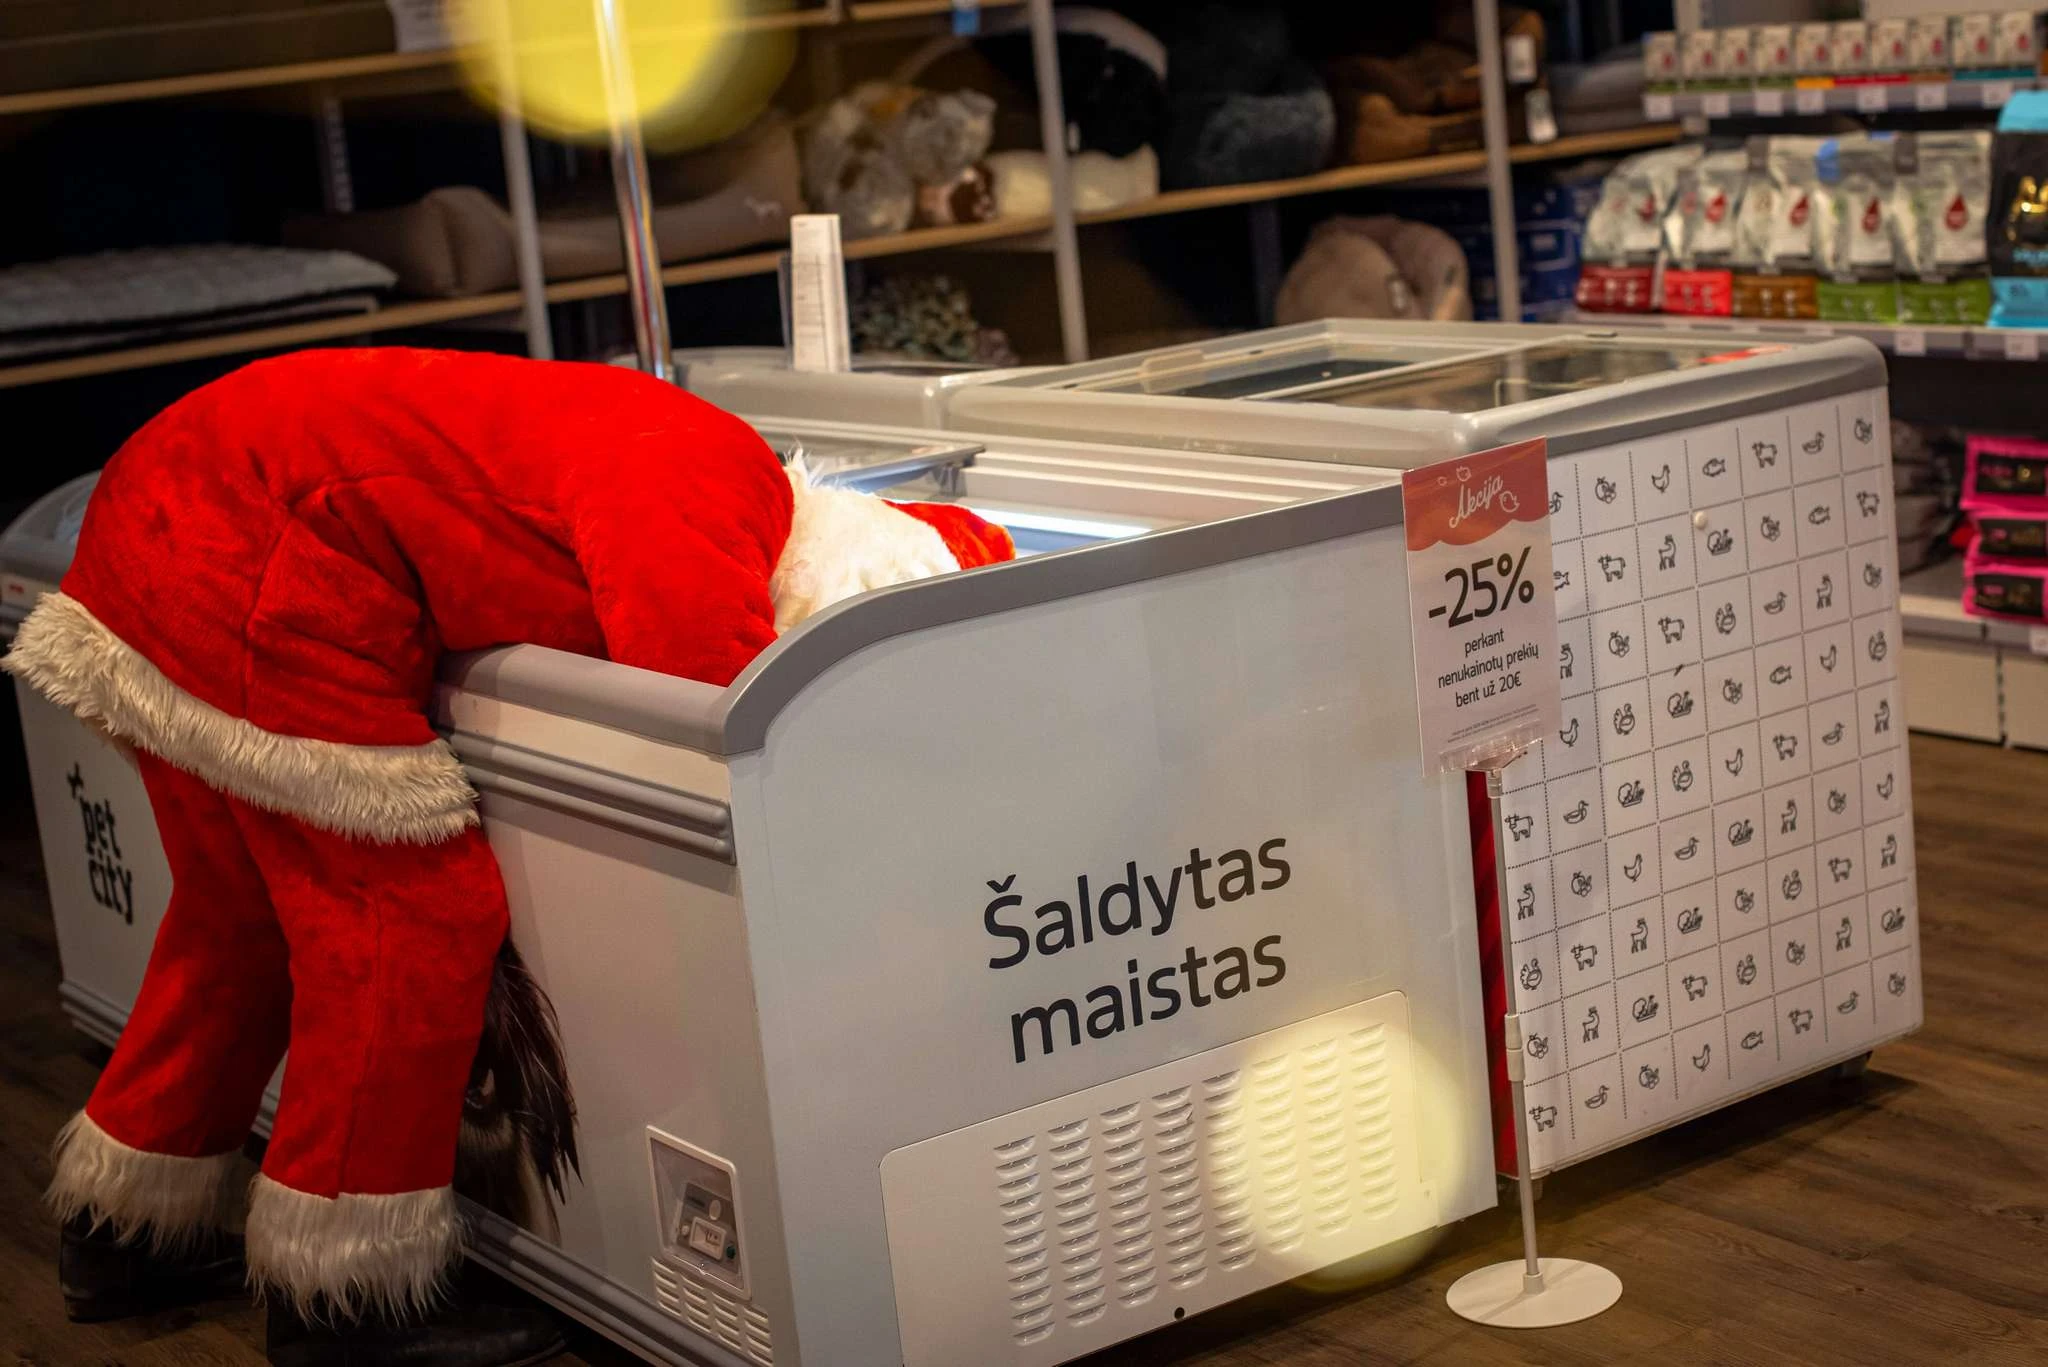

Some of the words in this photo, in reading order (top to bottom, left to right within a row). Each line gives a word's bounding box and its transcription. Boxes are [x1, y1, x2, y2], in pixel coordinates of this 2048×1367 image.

[1449, 475, 1503, 529] Akcija
[1428, 546, 1534, 628] -25%
[1438, 655, 1504, 688] nenukainotų
[1506, 643, 1539, 669] prekių
[1465, 628, 1504, 658] perkant
[1455, 687, 1480, 708] bent
[1482, 680, 1496, 699] už
[1498, 671, 1522, 693] 20€
[79, 797, 121, 859] pet
[88, 849, 133, 926] city
[983, 837, 1292, 970] Šaldytas
[1011, 934, 1287, 1064] maistas
